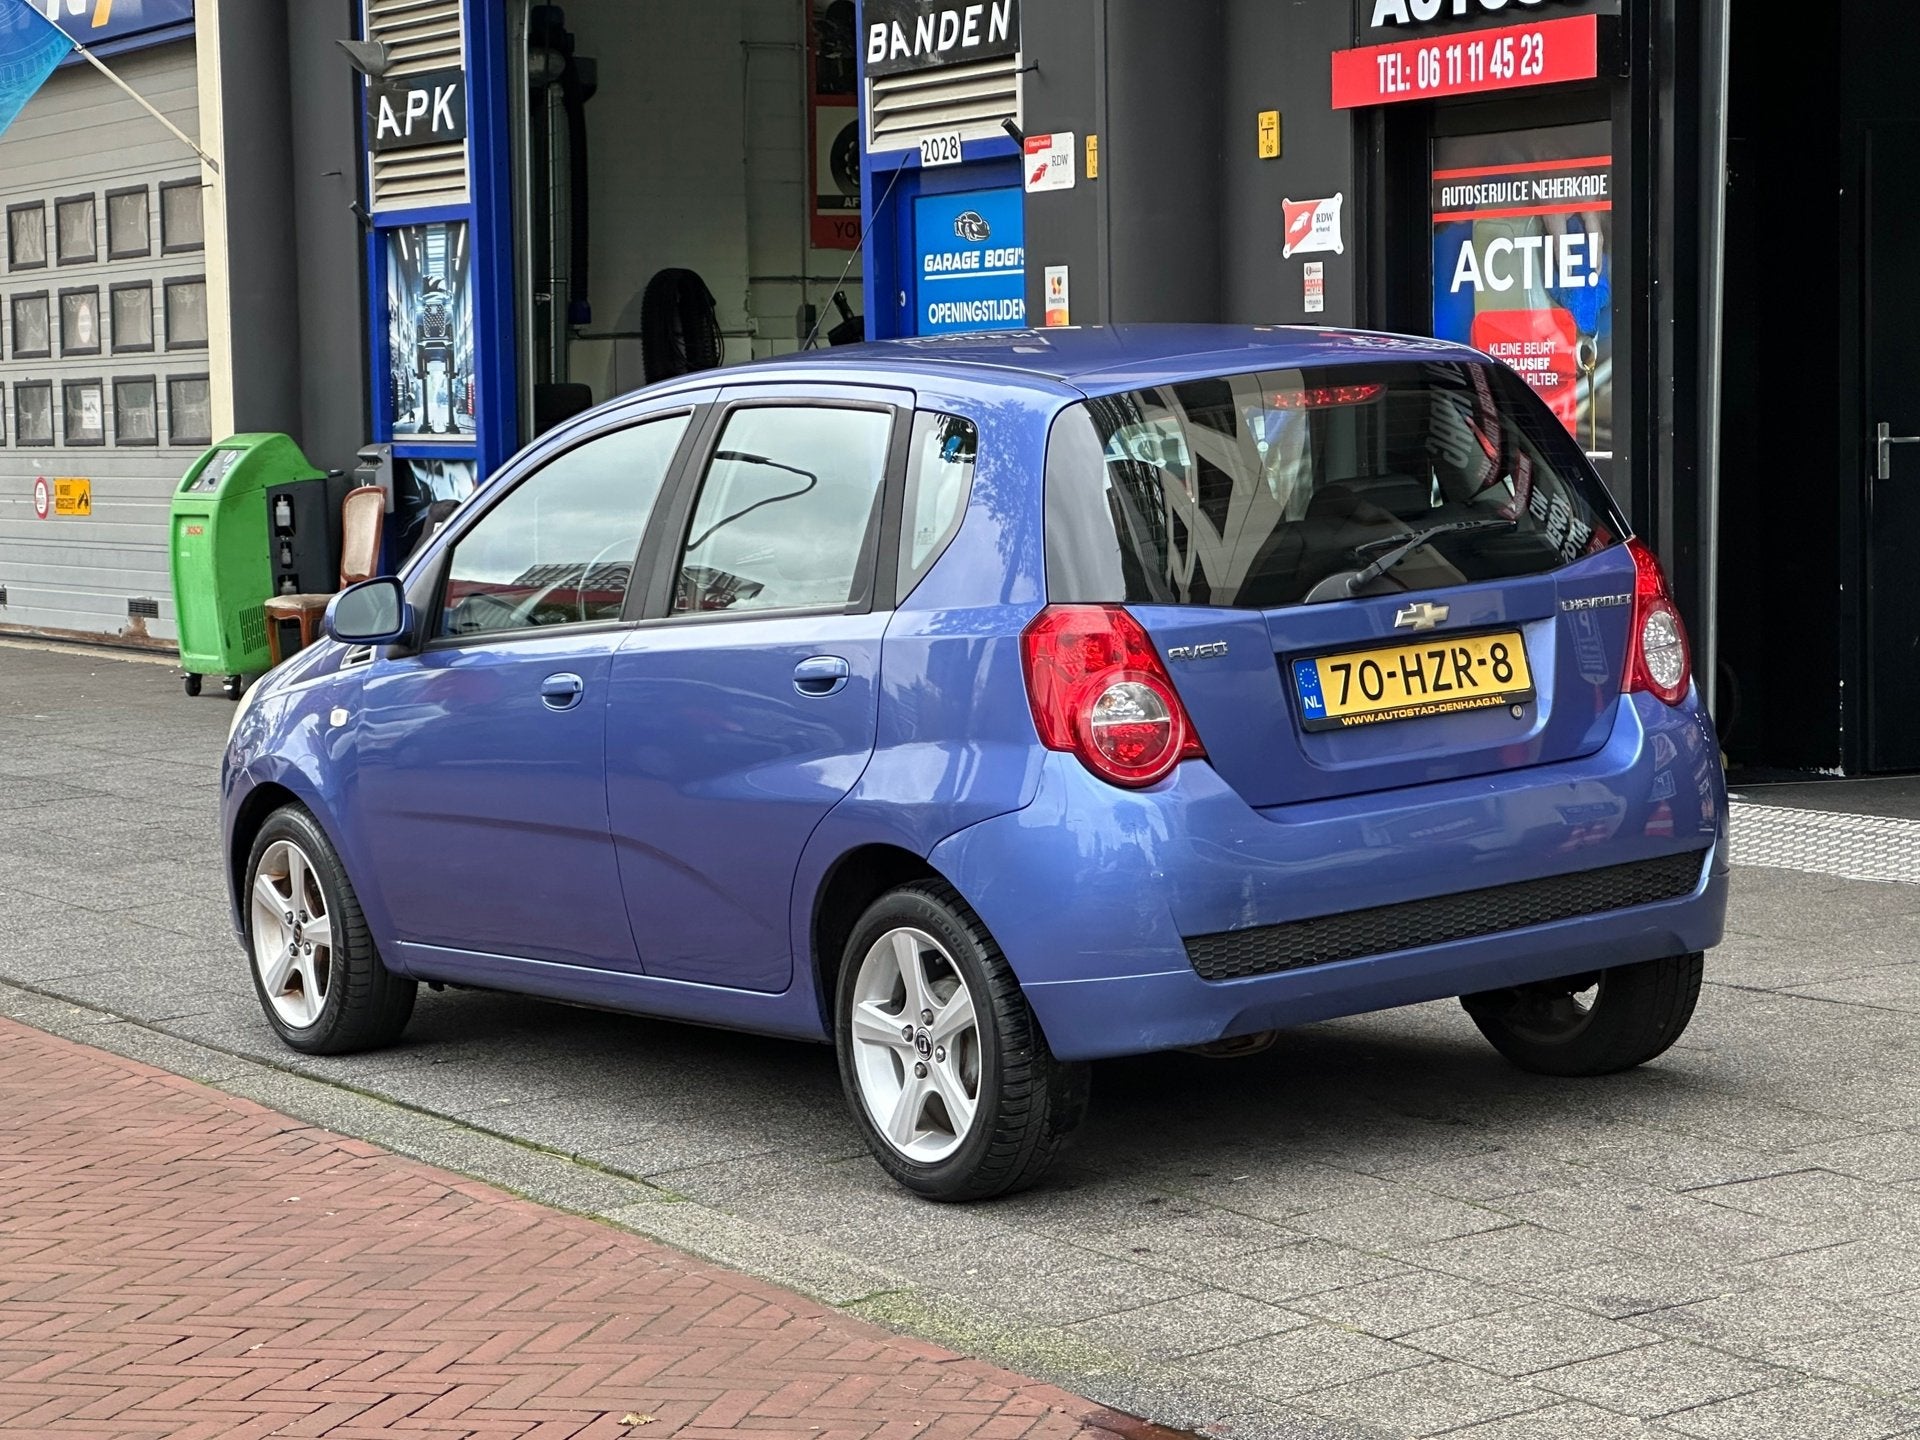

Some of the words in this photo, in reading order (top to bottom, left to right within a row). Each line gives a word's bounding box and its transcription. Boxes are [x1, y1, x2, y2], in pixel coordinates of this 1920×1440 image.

[867, 1, 1011, 63] BANDEN
[1376, 53, 1411, 94] TEL:
[1417, 47, 1440, 90] 06
[1446, 42, 1462, 85] 11
[1467, 41, 1484, 82] 11
[1490, 37, 1514, 79] 45
[1520, 32, 1544, 76] 23
[376, 83, 457, 139] APK
[921, 136, 959, 162] 2028
[1051, 154, 1069, 167] RDW
[1442, 181, 1529, 207] AUTOSERVICE
[1532, 174, 1608, 200] NEHERKADE
[1316, 212, 1334, 224] RDW
[924, 250, 980, 272] GARAGE
[1450, 232, 1599, 293] ACTIE!
[1489, 342, 1522, 356] KLEINE
[1524, 341, 1556, 355] BEURT
[1527, 372, 1559, 386] FILTER
[1561, 593, 1632, 611] CHEVROLET
[1168, 641, 1228, 662] AVEO
[1330, 642, 1513, 706] 70-HZR-8
[1304, 695, 1322, 709] NL
[1341, 695, 1506, 726] WWW.AUTOSTAD-DENHAAG.NL
